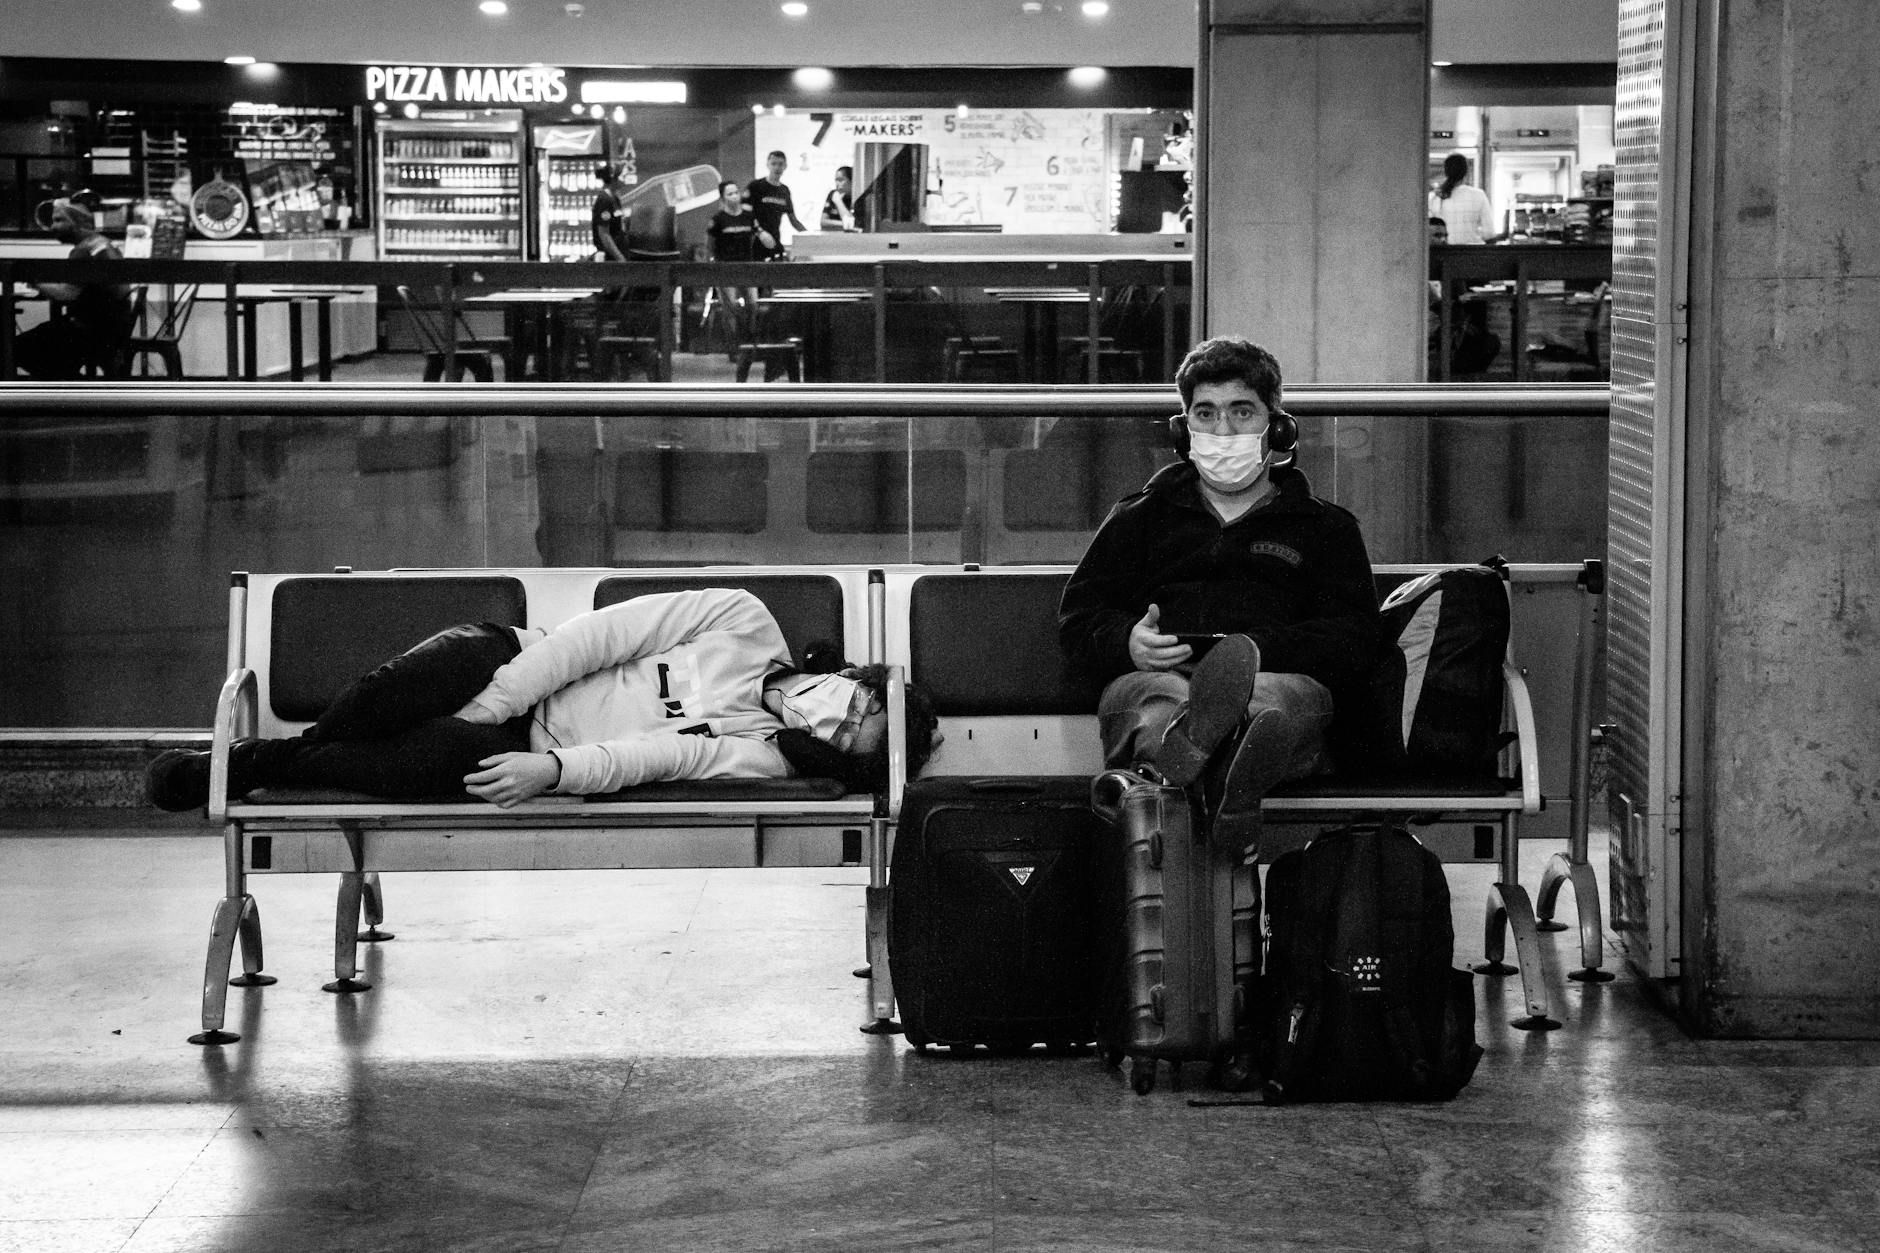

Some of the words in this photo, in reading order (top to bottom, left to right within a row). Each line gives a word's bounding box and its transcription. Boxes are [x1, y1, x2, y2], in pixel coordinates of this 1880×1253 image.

[365, 66, 448, 102] PIZZA
[455, 68, 568, 103] MAKERS
[810, 113, 833, 147] 7
[853, 123, 914, 136] MAKERS
[944, 114, 956, 133] 5
[1046, 155, 1060, 175] 6
[1003, 186, 1018, 206] 7
